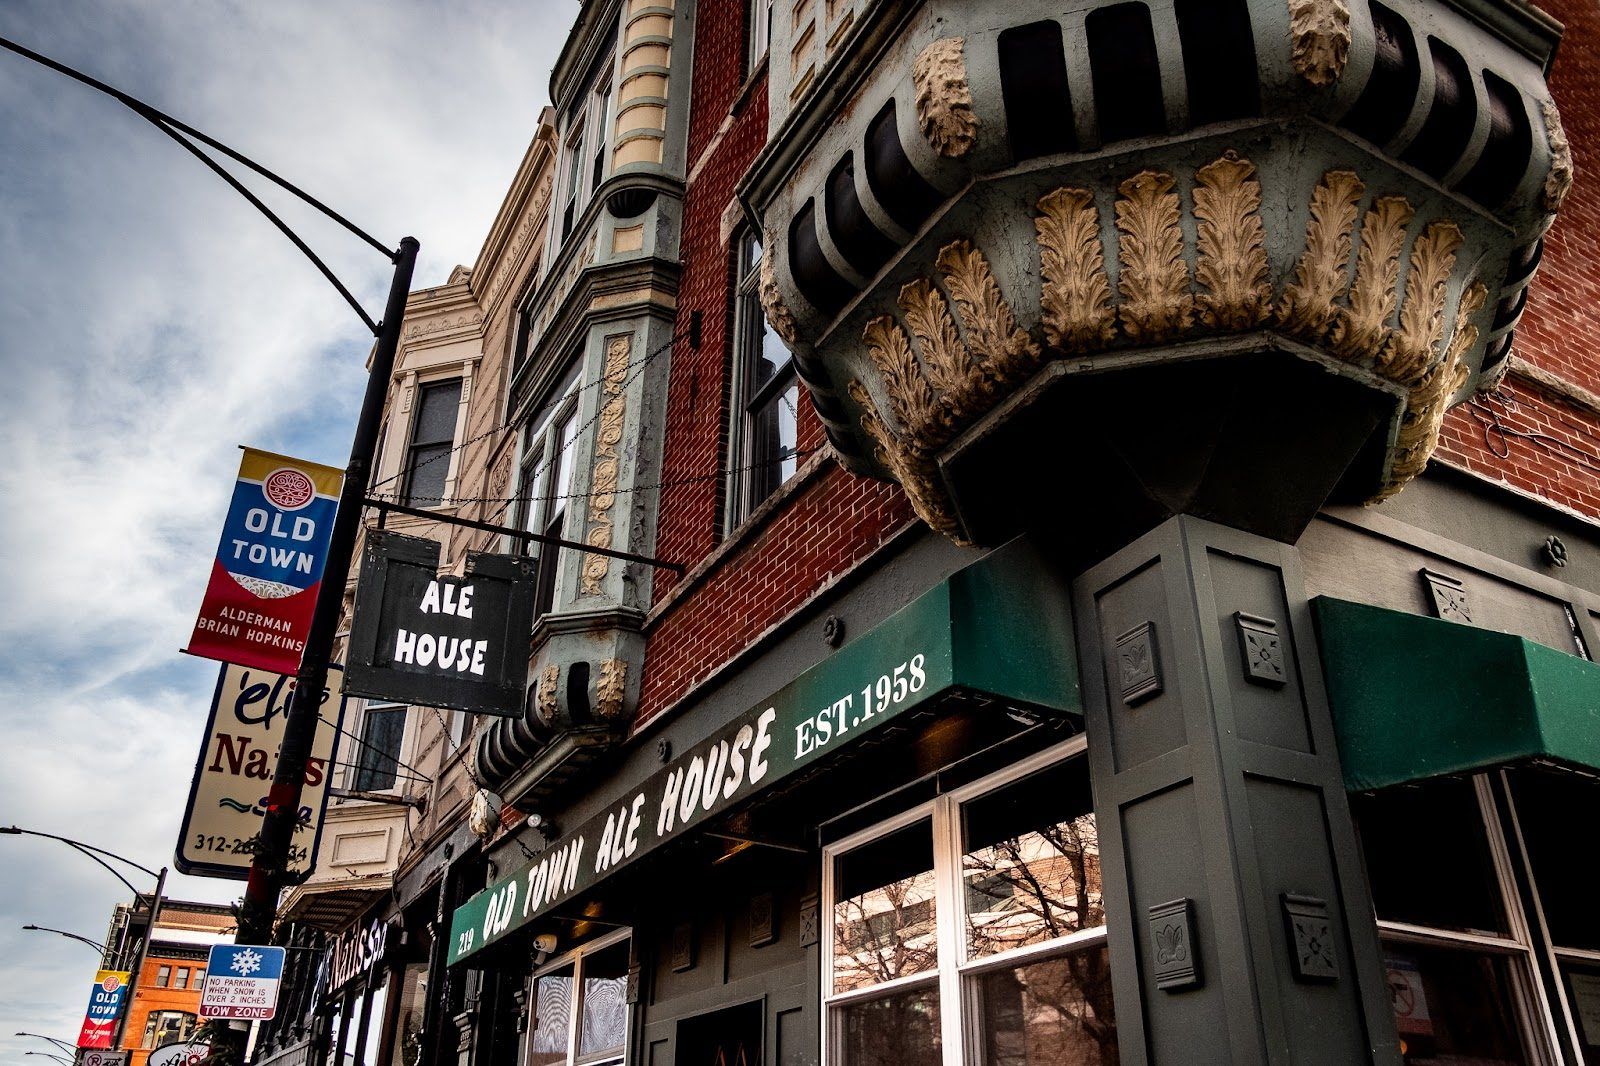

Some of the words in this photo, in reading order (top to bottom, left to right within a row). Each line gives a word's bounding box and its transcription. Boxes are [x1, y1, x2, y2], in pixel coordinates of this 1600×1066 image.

[244, 507, 316, 542] OLD
[231, 538, 315, 574] TOWN
[419, 580, 474, 619] ALE
[219, 605, 292, 633] ALDERMAN
[197, 617, 241, 637] BRIAN
[245, 628, 304, 653] HOPKINS
[393, 628, 488, 676] HOUSE
[457, 927, 475, 956] 219
[483, 879, 518, 942] OLD
[523, 835, 584, 918] TOWN
[595, 792, 646, 874] ALE
[657, 706, 777, 837] HOUSE
[794, 653, 927, 761] EST.1958
[208, 987, 229, 995] WHEN
[234, 987, 255, 996] SNOW
[225, 979, 255, 987] PARKING
[91, 1005, 117, 1015] TOWN
[96, 992, 119, 1003] OLD
[206, 995, 227, 1003] OVER
[240, 997, 266, 1005] INCHES
[204, 1006, 230, 1016] TOW
[235, 1007, 267, 1018] ZONE
